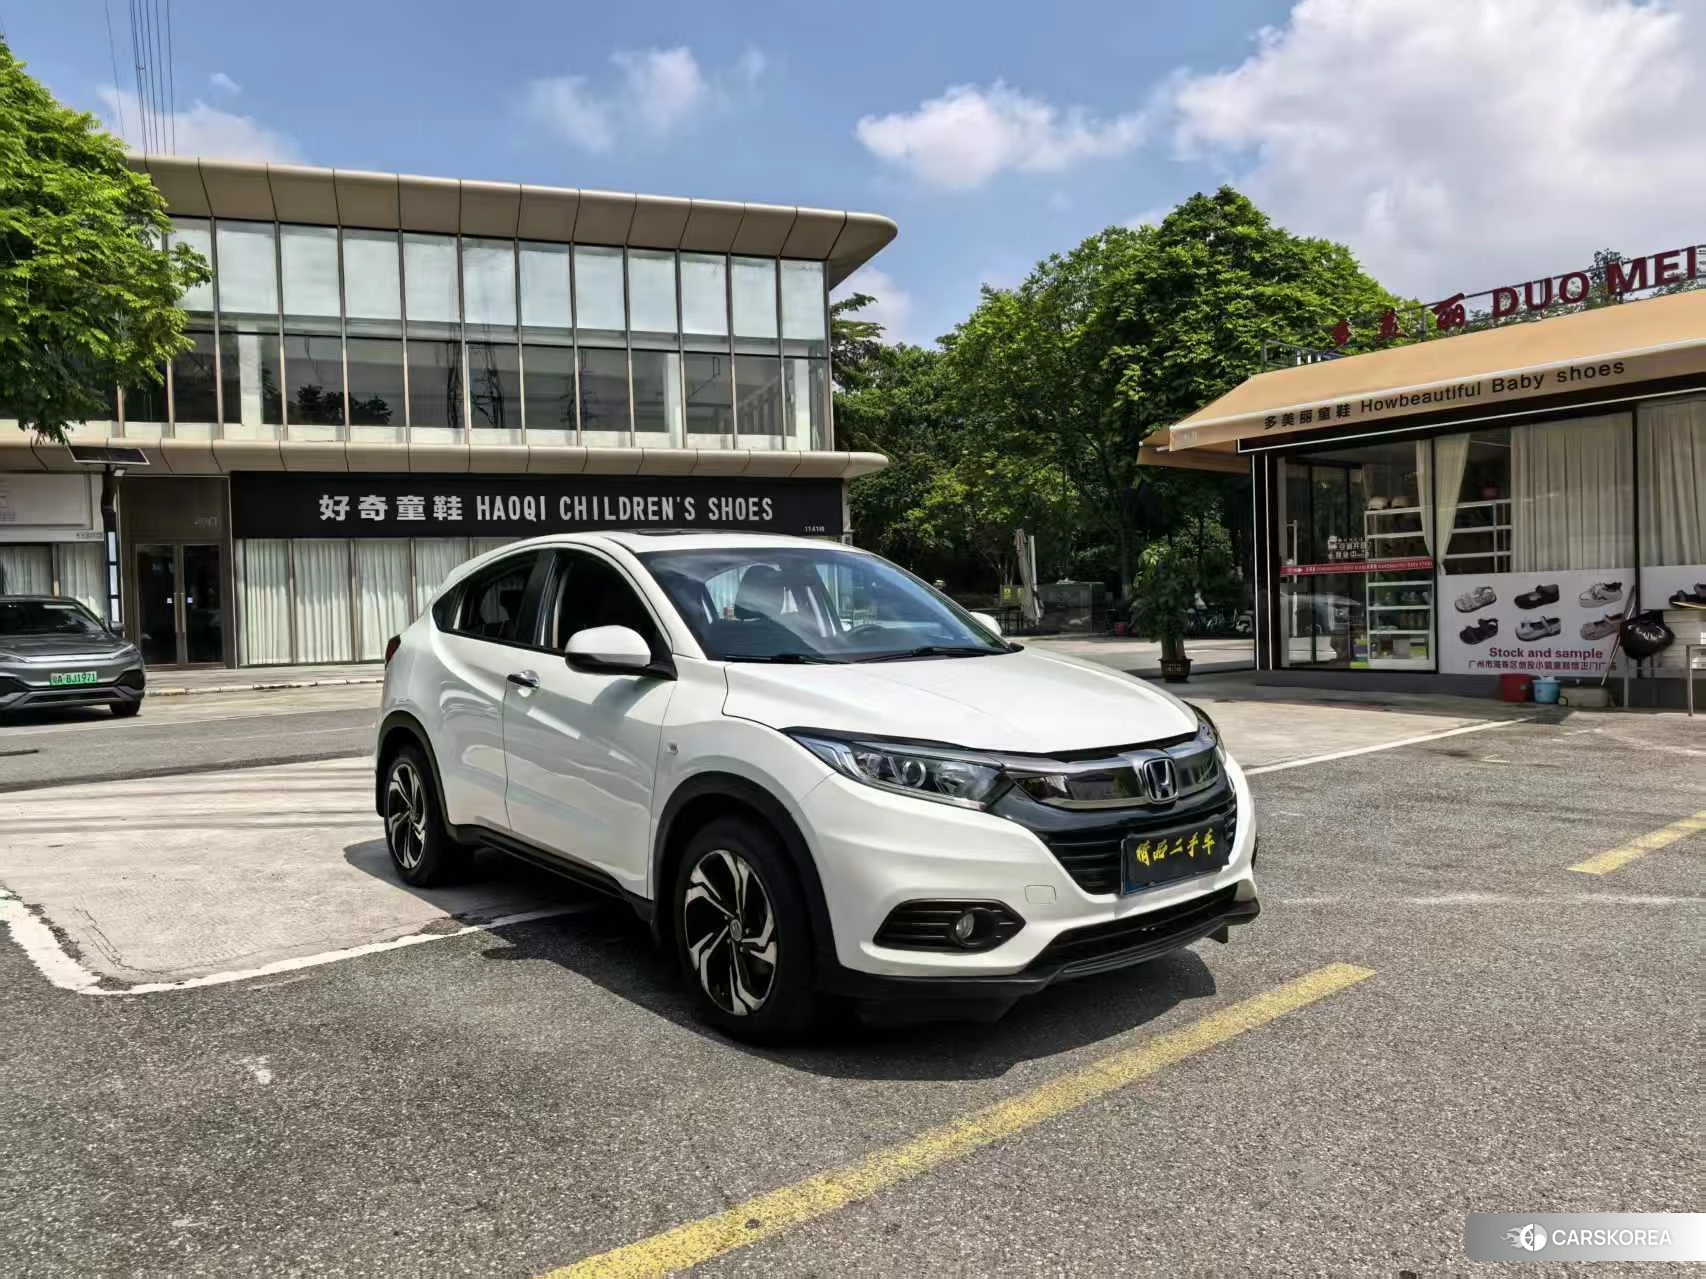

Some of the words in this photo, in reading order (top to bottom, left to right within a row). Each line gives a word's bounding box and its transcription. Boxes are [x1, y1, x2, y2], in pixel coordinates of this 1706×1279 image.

[1491, 271, 1591, 319] DUO
[1606, 245, 1697, 296] MEI
[1264, 401, 1351, 430] 多美丽童鞋
[1491, 371, 1545, 393] Baby
[1556, 359, 1625, 384] shoes
[319, 494, 463, 521] 好奇童鞋
[477, 495, 547, 521] HAOQI
[559, 495, 697, 521] CHILDREN'S
[708, 497, 774, 521] SHOES
[1489, 648, 1524, 658] Stock
[1528, 648, 1551, 658] and
[1555, 648, 1603, 660] sample
